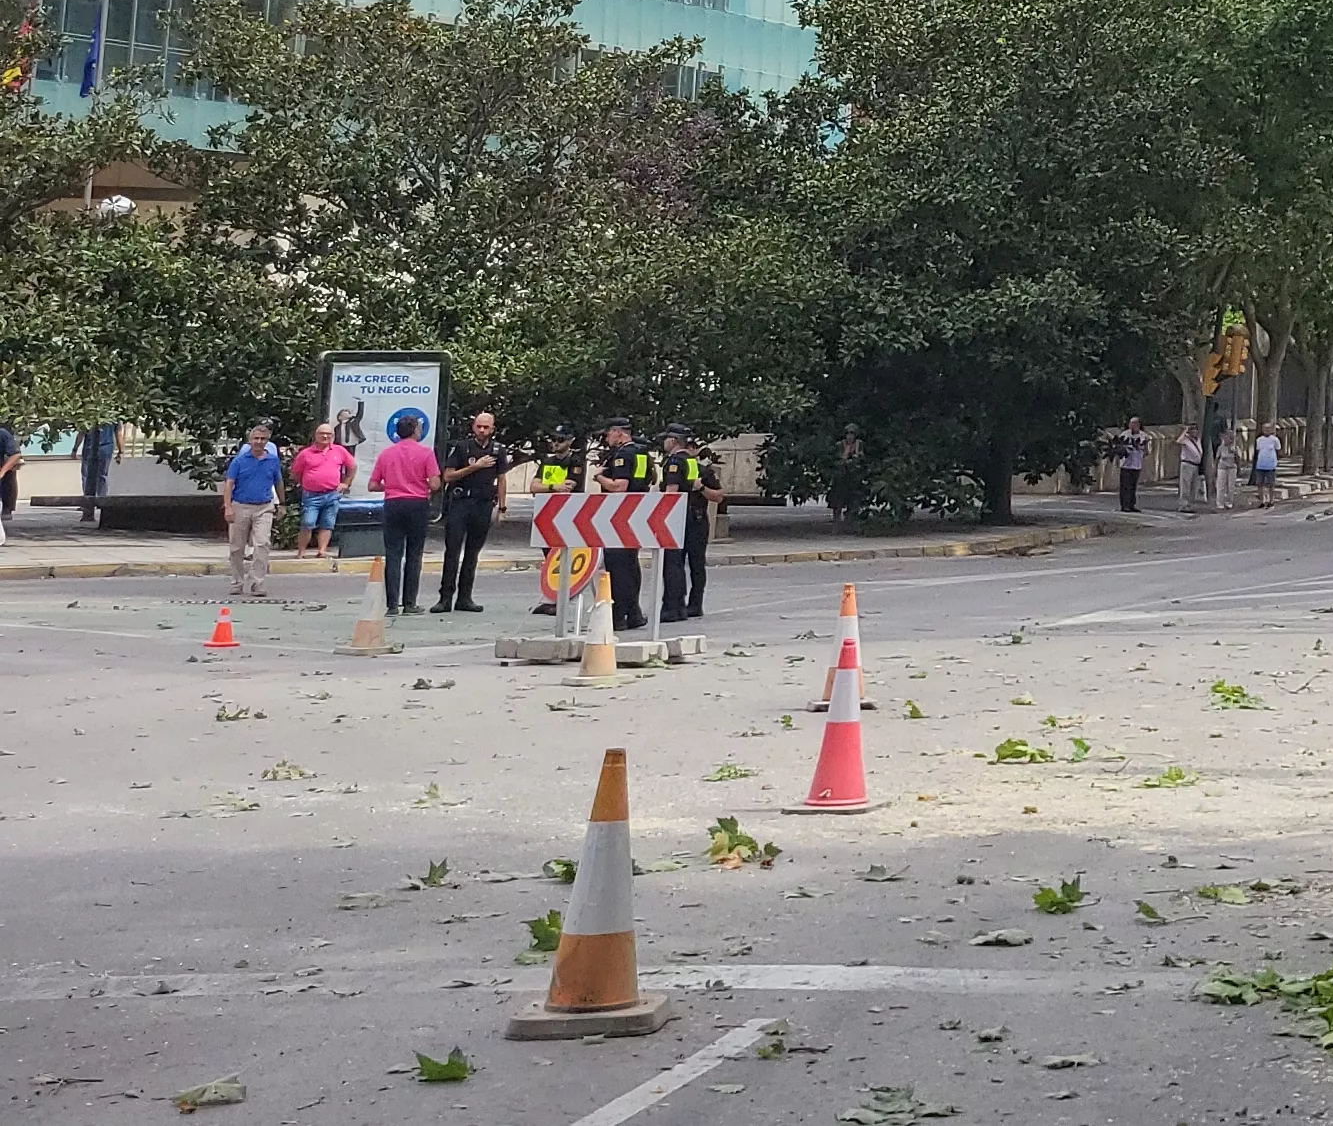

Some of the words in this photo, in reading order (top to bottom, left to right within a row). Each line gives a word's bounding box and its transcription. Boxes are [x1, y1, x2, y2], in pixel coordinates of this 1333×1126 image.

[336, 375, 361, 383] HAZ
[364, 375, 410, 383] CRECER
[360, 385, 375, 394] TU
[378, 385, 431, 394] NEGOCIO
[552, 553, 587, 575] 20
